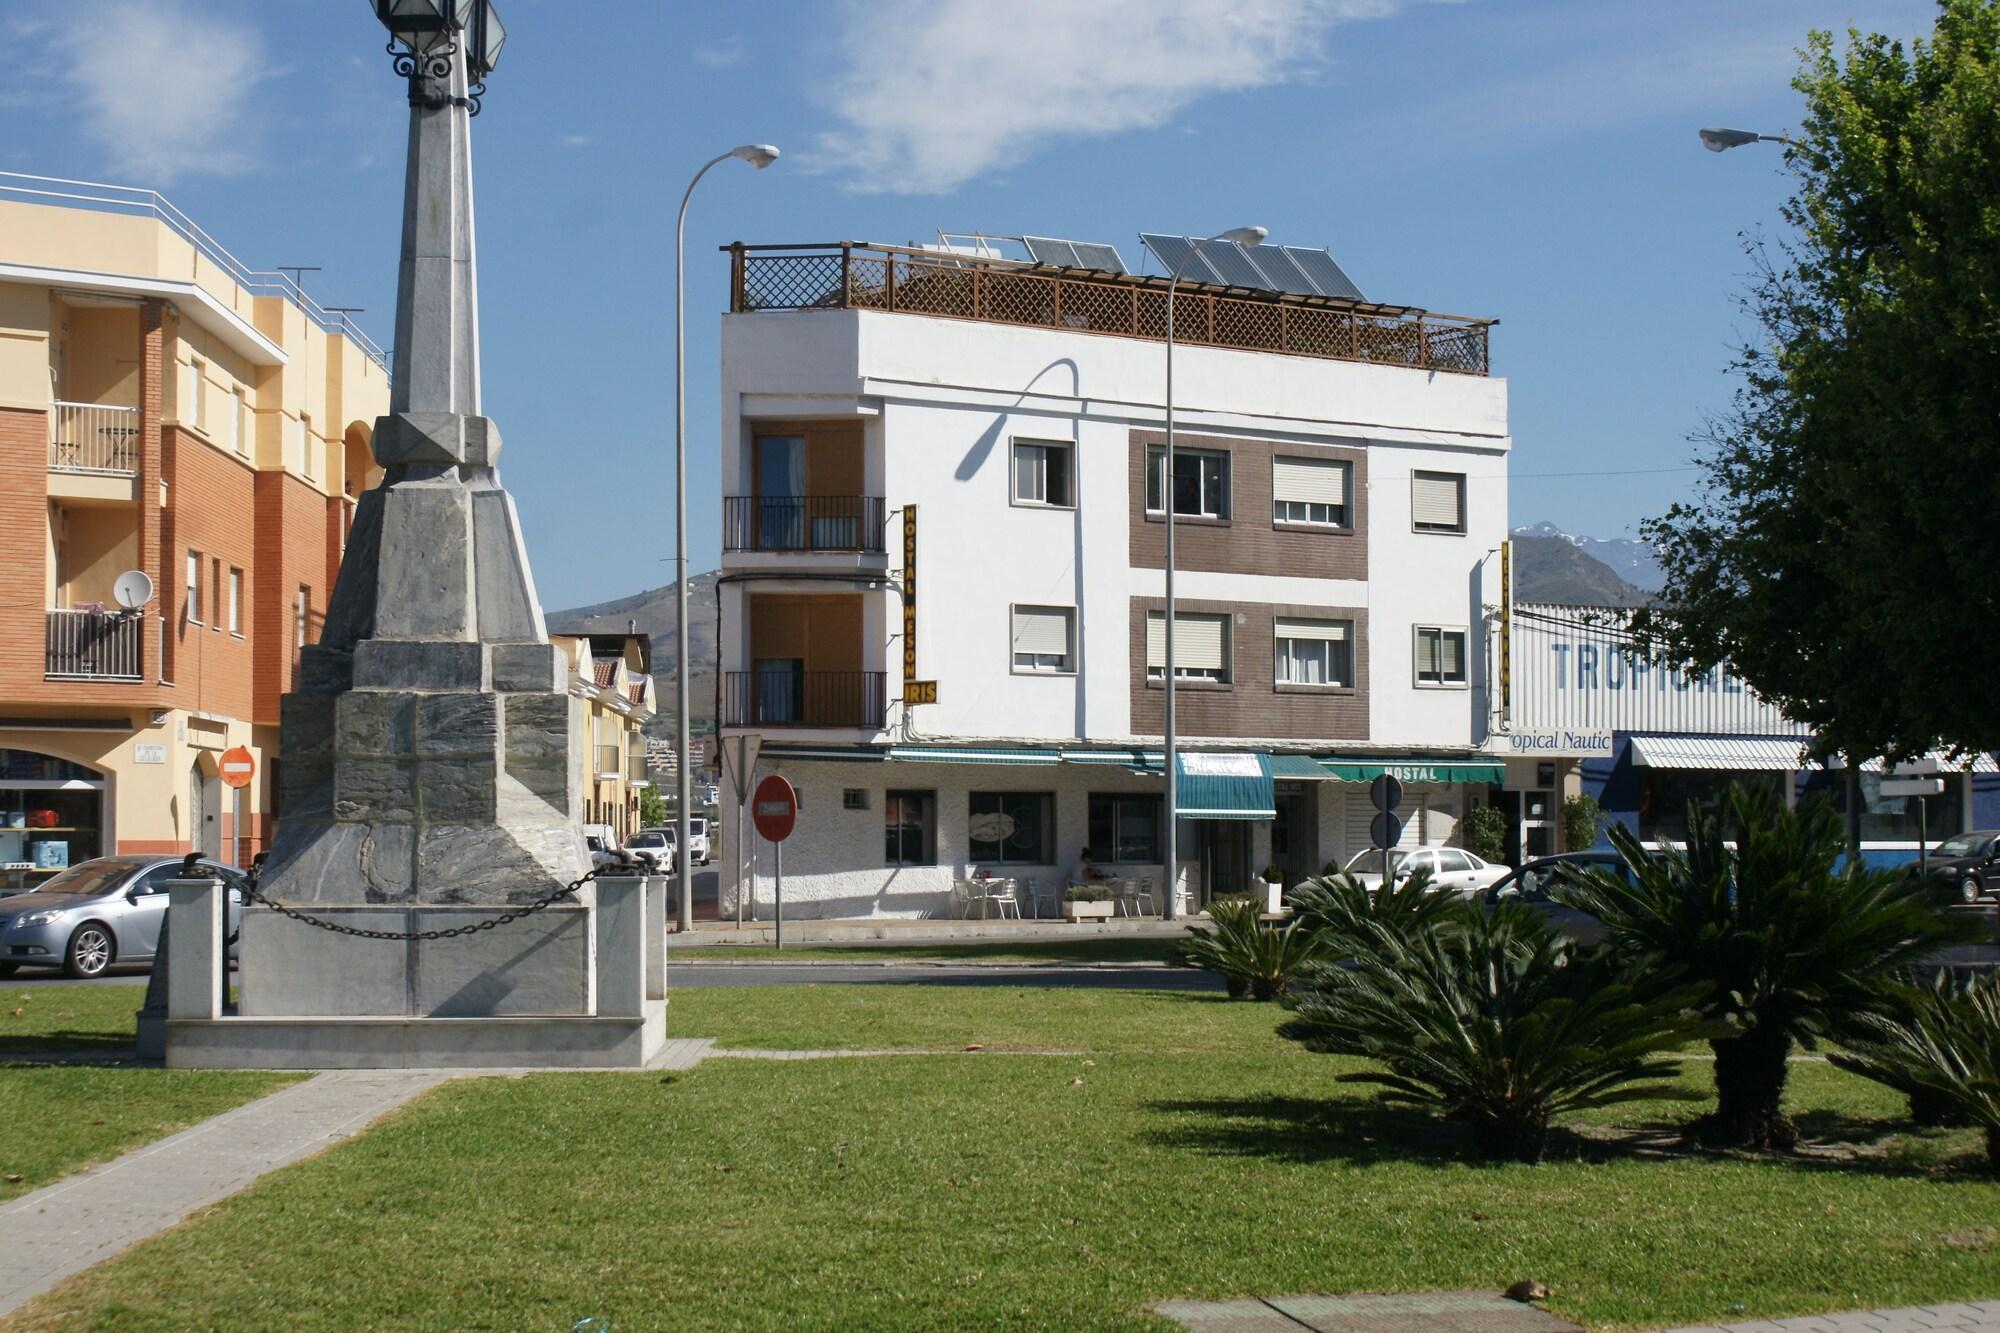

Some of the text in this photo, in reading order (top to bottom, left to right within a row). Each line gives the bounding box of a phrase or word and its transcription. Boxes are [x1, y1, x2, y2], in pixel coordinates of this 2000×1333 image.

[904, 509, 916, 678] HOSTAL MESON
[904, 683, 937, 704] IRIS
[1509, 729, 1610, 753] opical Nautic
[1384, 766, 1437, 780] HOSTAL
